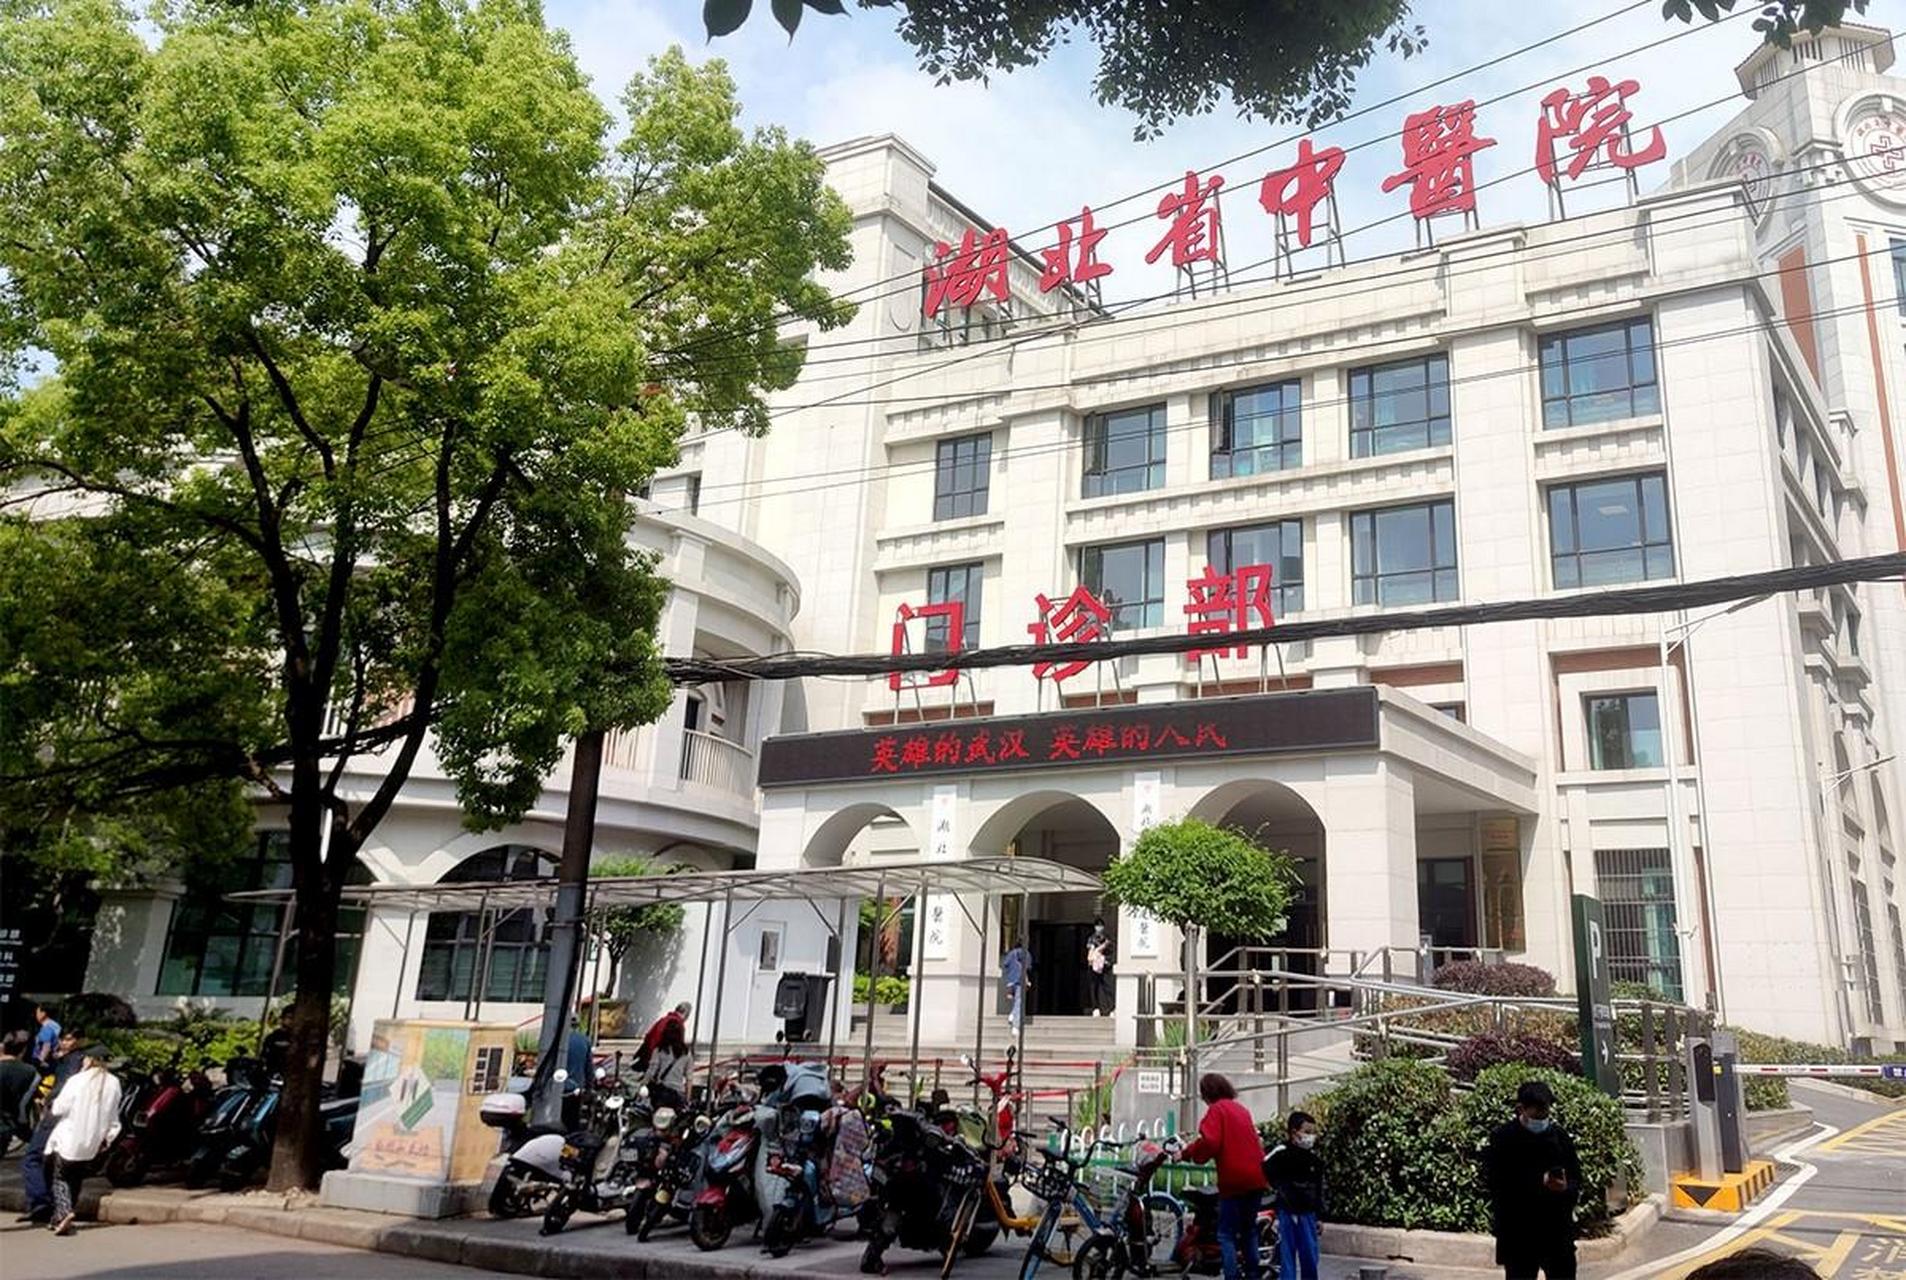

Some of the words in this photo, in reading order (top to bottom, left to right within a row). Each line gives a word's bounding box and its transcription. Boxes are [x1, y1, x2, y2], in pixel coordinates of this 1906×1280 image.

[923, 77, 1664, 320] 湖北省中醫院
[889, 563, 1274, 691] 门诊部
[871, 730, 1030, 773] 英雄的武汉
[1048, 724, 1228, 760] 英雄的人民
[1589, 919, 1602, 980] P
